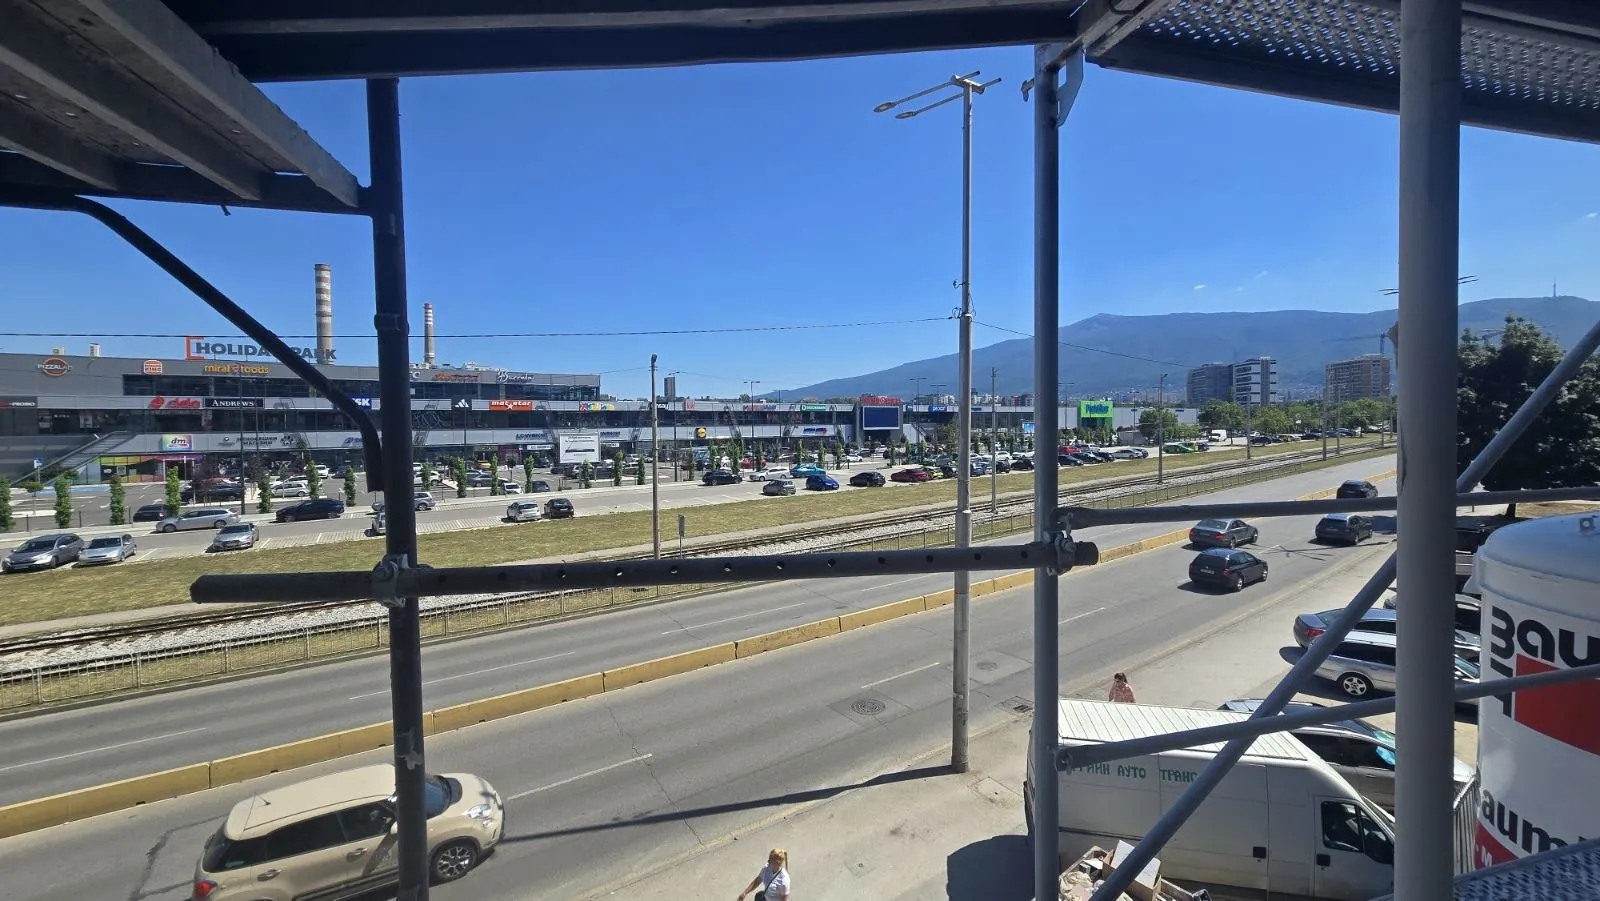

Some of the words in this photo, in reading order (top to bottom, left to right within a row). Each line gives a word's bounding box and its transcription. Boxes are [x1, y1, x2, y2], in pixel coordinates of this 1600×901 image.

[195, 342, 271, 357] HOLIDA
[240, 365, 269, 375] foods
[1117, 764, 1147, 779] АУТО
